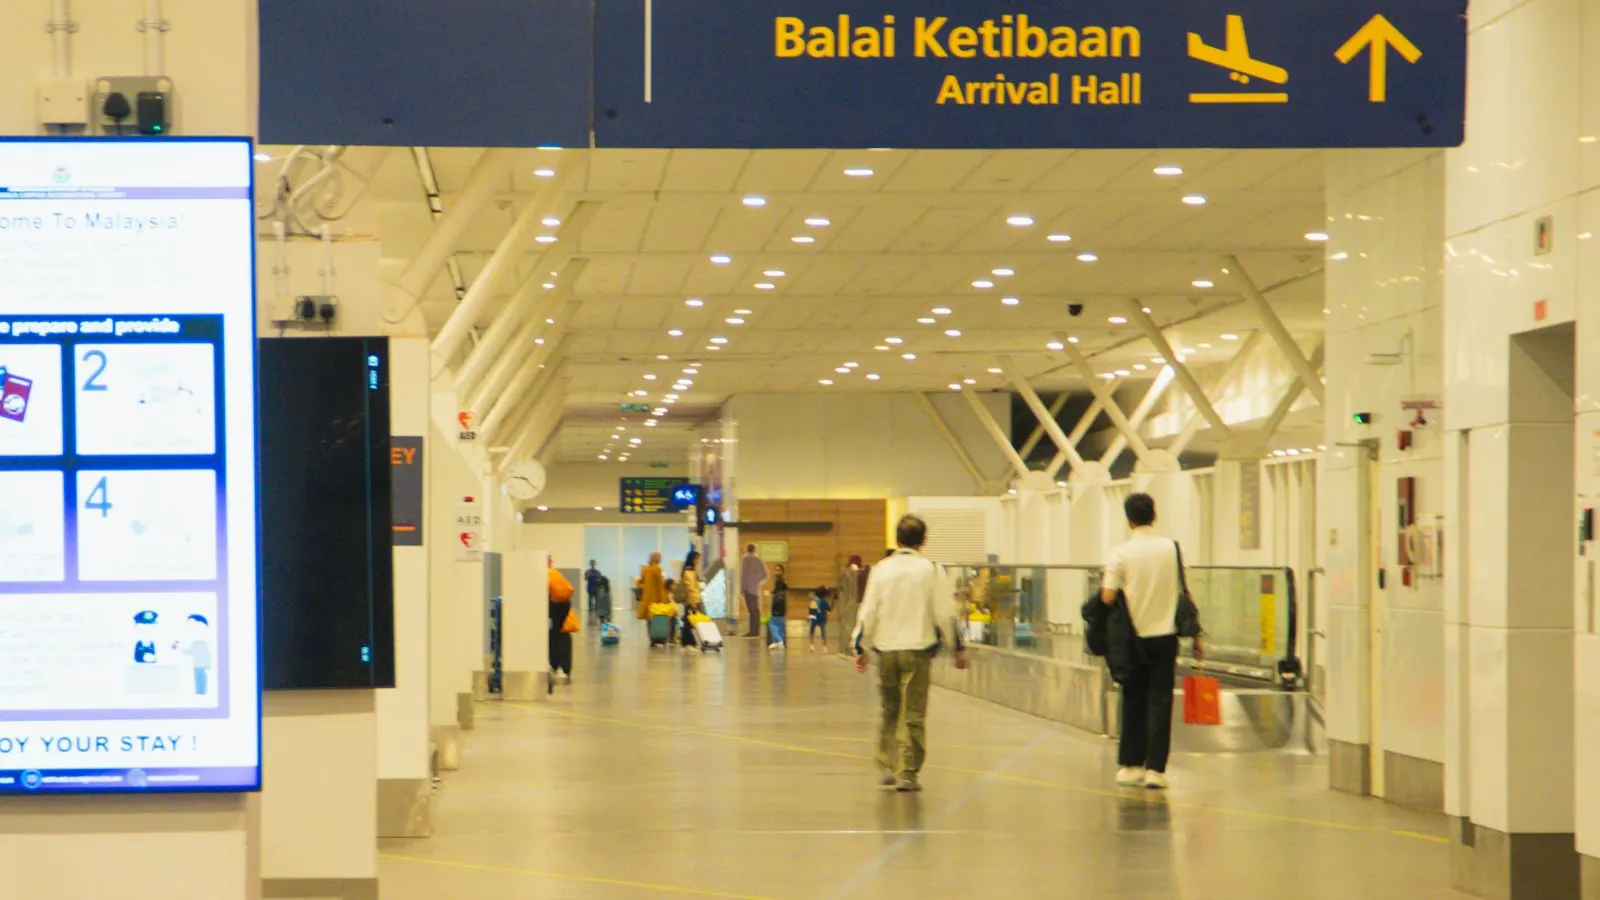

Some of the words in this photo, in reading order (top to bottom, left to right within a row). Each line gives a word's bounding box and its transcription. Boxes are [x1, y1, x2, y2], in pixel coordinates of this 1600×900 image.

[774, 14, 896, 58] Balai
[913, 13, 1141, 58] Ketibaan
[936, 72, 1060, 106] Arrival
[1071, 72, 1142, 106] Hall
[52, 212, 76, 230] To
[12, 321, 78, 337] prepare
[80, 318, 113, 334] and
[115, 318, 180, 337] provide
[81, 348, 110, 393] 2
[390, 447, 417, 465] EY
[84, 475, 113, 518] 4
[40, 735, 111, 754] YOUR
[119, 735, 183, 753] STAY
